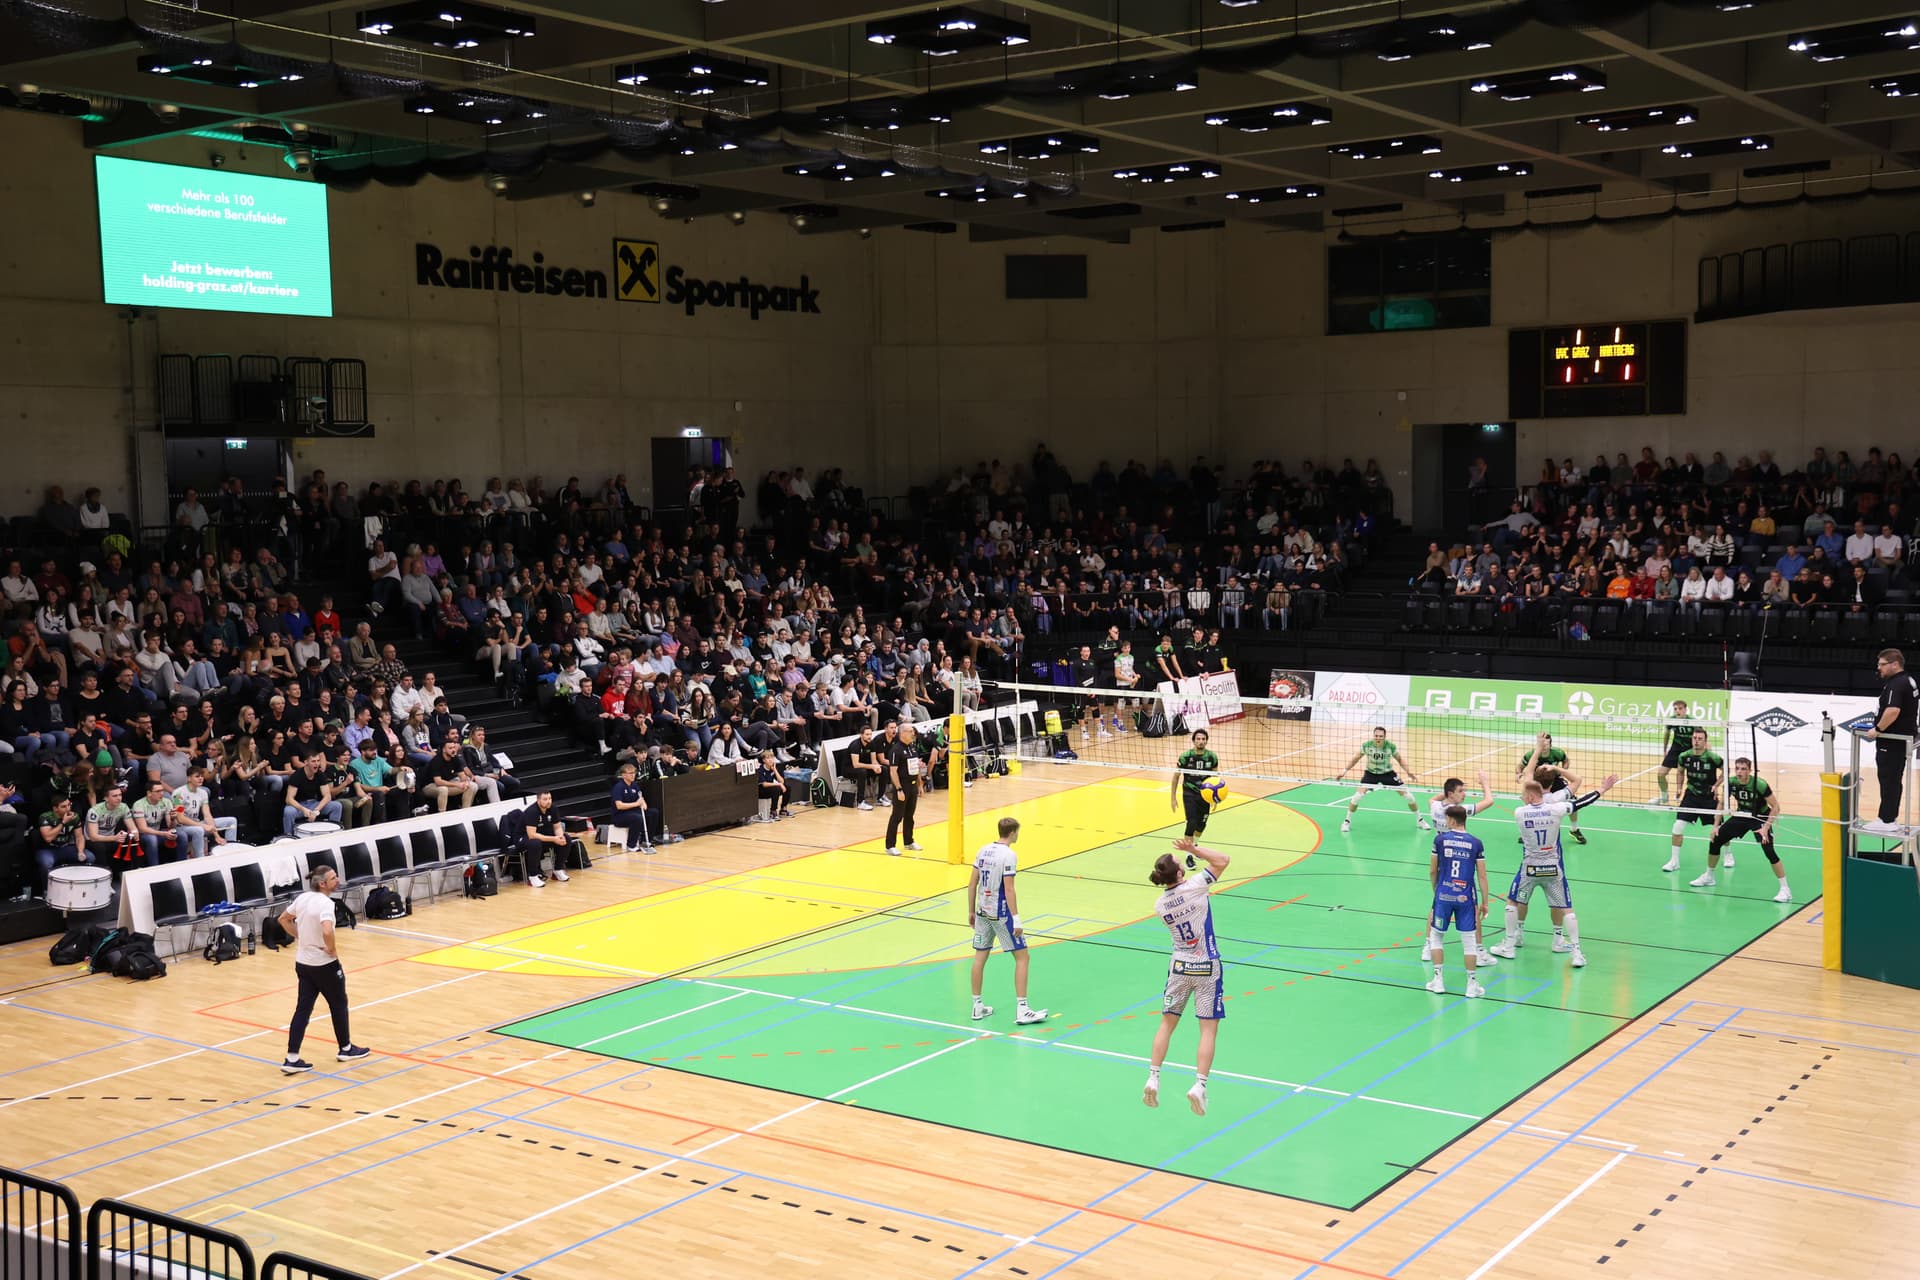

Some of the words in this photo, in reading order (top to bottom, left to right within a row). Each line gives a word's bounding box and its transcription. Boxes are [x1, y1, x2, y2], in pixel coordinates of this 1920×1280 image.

[181, 189, 212, 202] Mehr
[214, 192, 230, 204] als
[233, 194, 255, 206] 100
[147, 201, 221, 219] verschiedene
[224, 208, 288, 225] Berufsfelder
[170, 261, 202, 275] Jetzt
[205, 263, 273, 280] bewerben:
[143, 274, 300, 297] holding-graz.at/karriere
[415, 243, 608, 298] Raiffeisen
[665, 265, 821, 320] Sportpark
[1204, 680, 1237, 696] Geolith
[1534, 829, 1547, 846] 17
[1451, 860, 1461, 878] 8
[1164, 895, 1185, 911] THALLER
[1173, 905, 1196, 920] HAAS
[1176, 920, 1195, 941] 13
